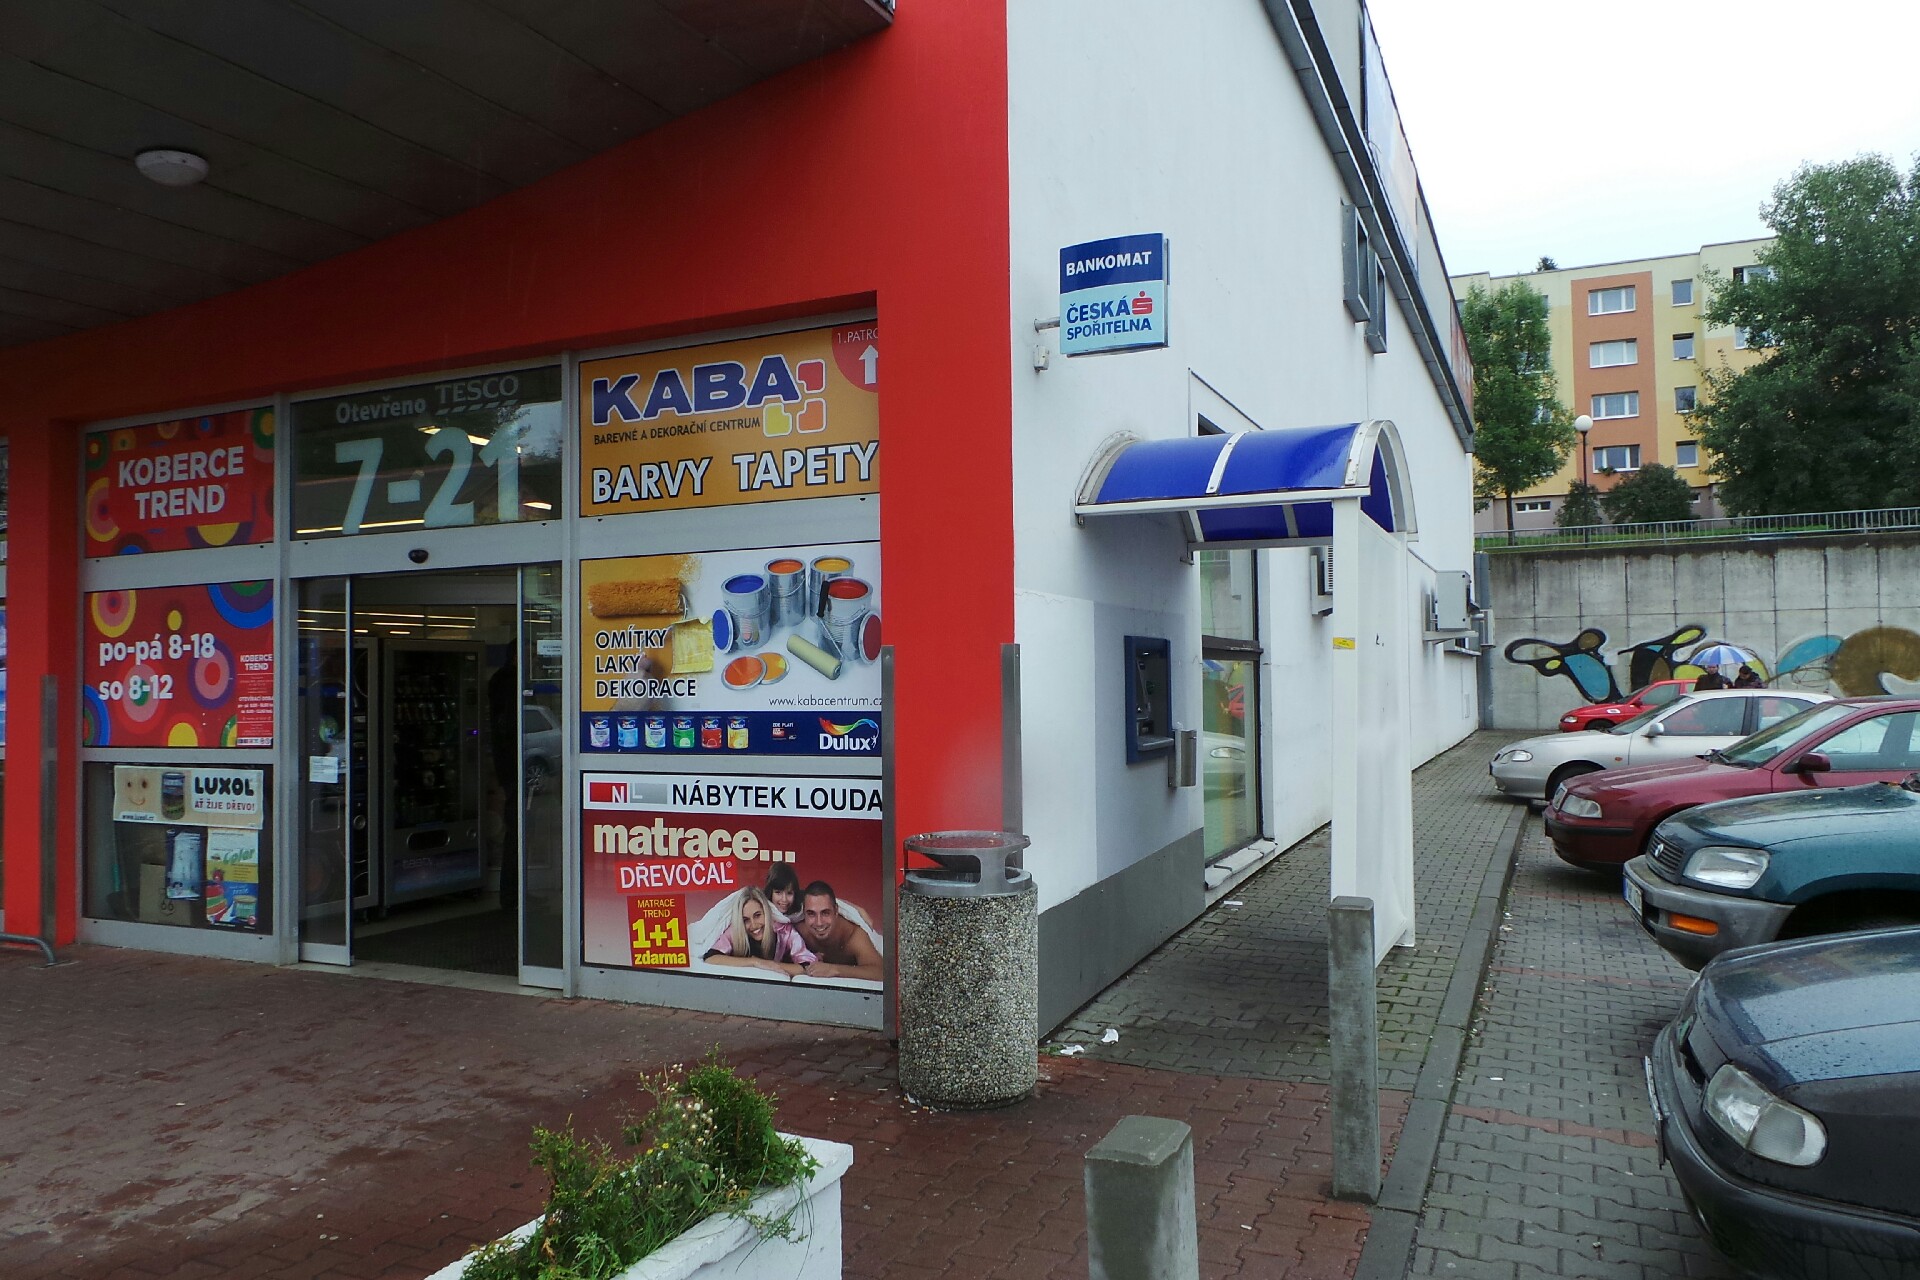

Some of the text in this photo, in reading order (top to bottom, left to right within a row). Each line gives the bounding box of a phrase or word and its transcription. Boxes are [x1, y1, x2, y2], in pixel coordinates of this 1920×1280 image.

[1066, 251, 1152, 276] BANKOMAT
[1066, 295, 1131, 324] ČESKÁ
[1066, 318, 1152, 340] SPOŘITELNA
[336, 375, 519, 424] Otevřeno TESCO
[592, 354, 800, 425] KABA
[594, 417, 760, 445] BAREVNÉ A DEKORAČNÍ CENTRUM
[118, 446, 244, 488] KOBERCE
[592, 440, 879, 504] BARVY TAPETY
[135, 484, 226, 520] TREND
[99, 632, 216, 666] po-pá 8-18
[595, 625, 668, 650] OMÍTKY
[595, 655, 641, 674] LAKY
[98, 675, 173, 700] so 8-12
[595, 679, 697, 699] DEKORACE
[769, 693, 882, 706] www.kabacentrum.cz
[819, 733, 871, 750] Dulux
[194, 776, 254, 796] LUXOL
[672, 780, 882, 812] NÁBYTEK LOUDA
[207, 799, 223, 810] ŽIJE
[226, 800, 255, 811] DŘEVO!
[593, 818, 796, 863] matrace...
[637, 898, 675, 908] MATRACE
[643, 909, 671, 918] TREND
[632, 918, 686, 948] 1+1
[634, 950, 687, 965] zdarma
